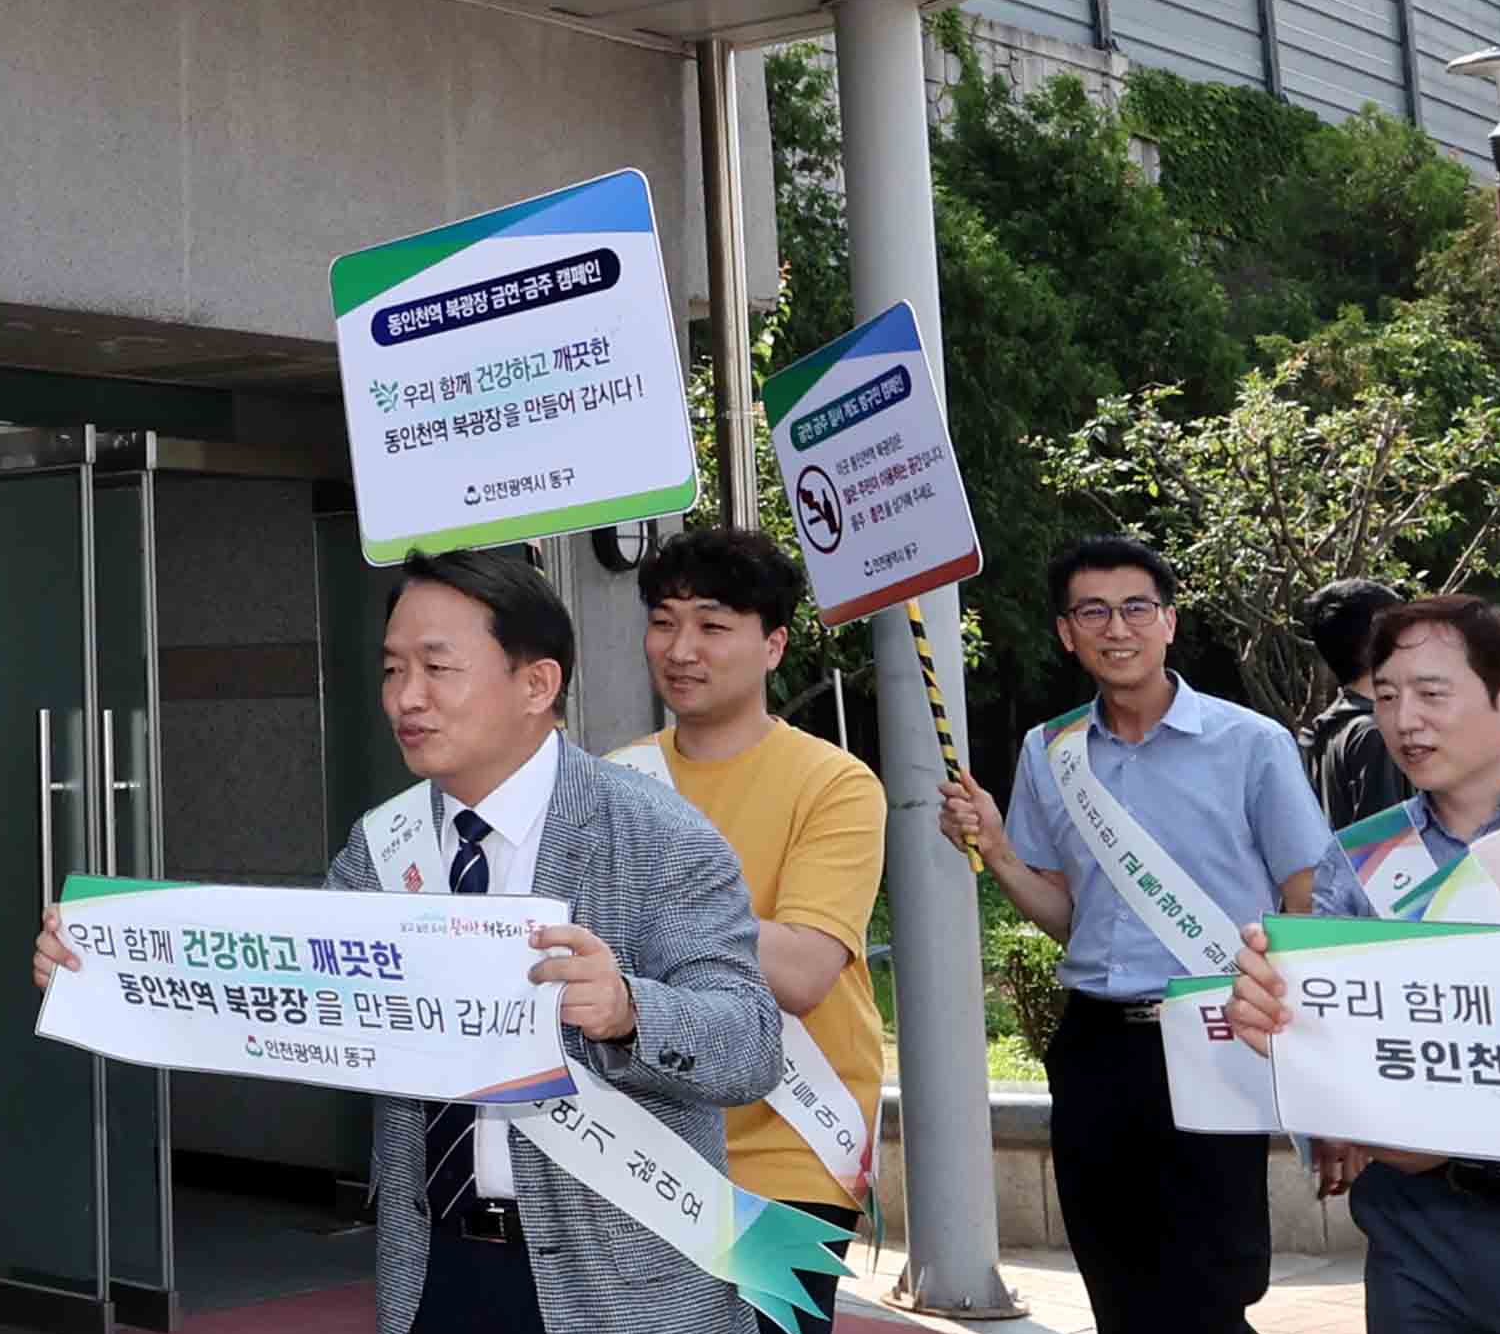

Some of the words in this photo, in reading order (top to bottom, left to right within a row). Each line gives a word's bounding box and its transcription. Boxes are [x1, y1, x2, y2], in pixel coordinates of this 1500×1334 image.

[388, 302, 443, 336] 동인천역
[445, 291, 488, 323] 북광장
[556, 259, 602, 291] 캠페인
[404, 381, 435, 408] 우리
[440, 371, 472, 400] 함께
[477, 353, 549, 393] 건강하고
[553, 336, 610, 372] 깨끗한
[385, 417, 448, 454] 동인천역
[453, 405, 520, 439] 북광장을
[524, 389, 576, 424] 만들어
[483, 474, 545, 502] 인천광역시
[550, 467, 576, 491] 동구
[123, 926, 173, 963] 함께
[182, 930, 301, 973] 건강하고
[309, 936, 403, 981] 깨끗한
[119, 975, 220, 1019] 동인천역
[225, 981, 342, 1028] 북광장을
[354, 990, 445, 1033] 만들어
[458, 997, 536, 1039] 갑시다!
[1300, 976, 1384, 1022] 우리
[1405, 979, 1493, 1028] 함께
[266, 1036, 338, 1068] 인천광역시
[344, 1042, 377, 1068] 동구
[535, 1093, 616, 1155] 연기
[628, 1149, 704, 1225] 싫어요
